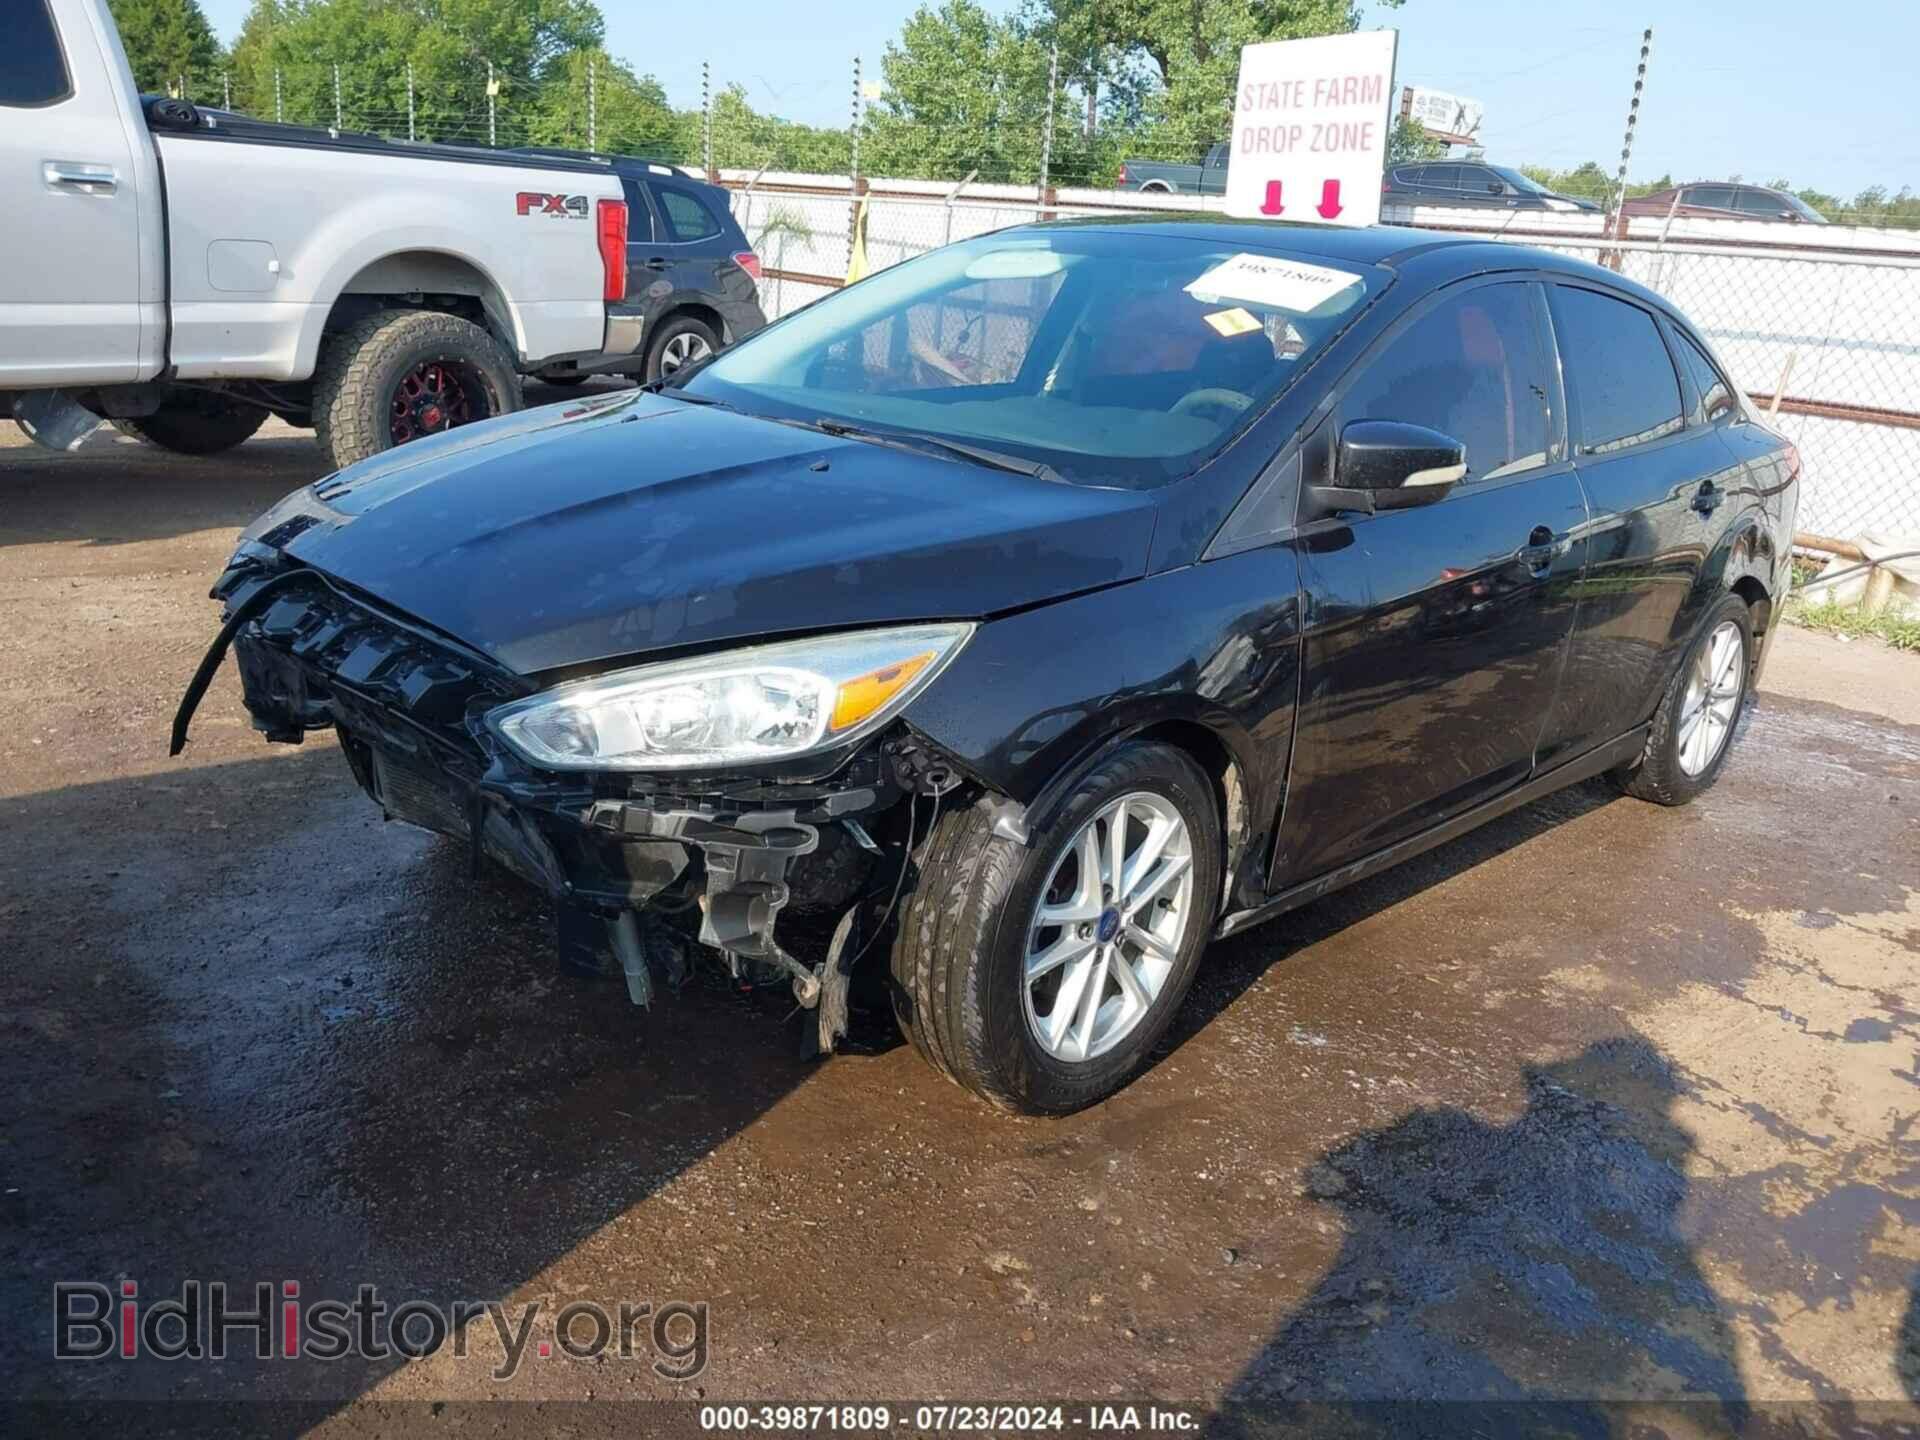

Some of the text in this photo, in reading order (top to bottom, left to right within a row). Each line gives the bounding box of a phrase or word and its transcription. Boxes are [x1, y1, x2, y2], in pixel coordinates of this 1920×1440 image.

[1241, 74, 1383, 112] STATE FARM
[1240, 121, 1375, 155] DROP ZONE
[516, 191, 589, 216] FX4
